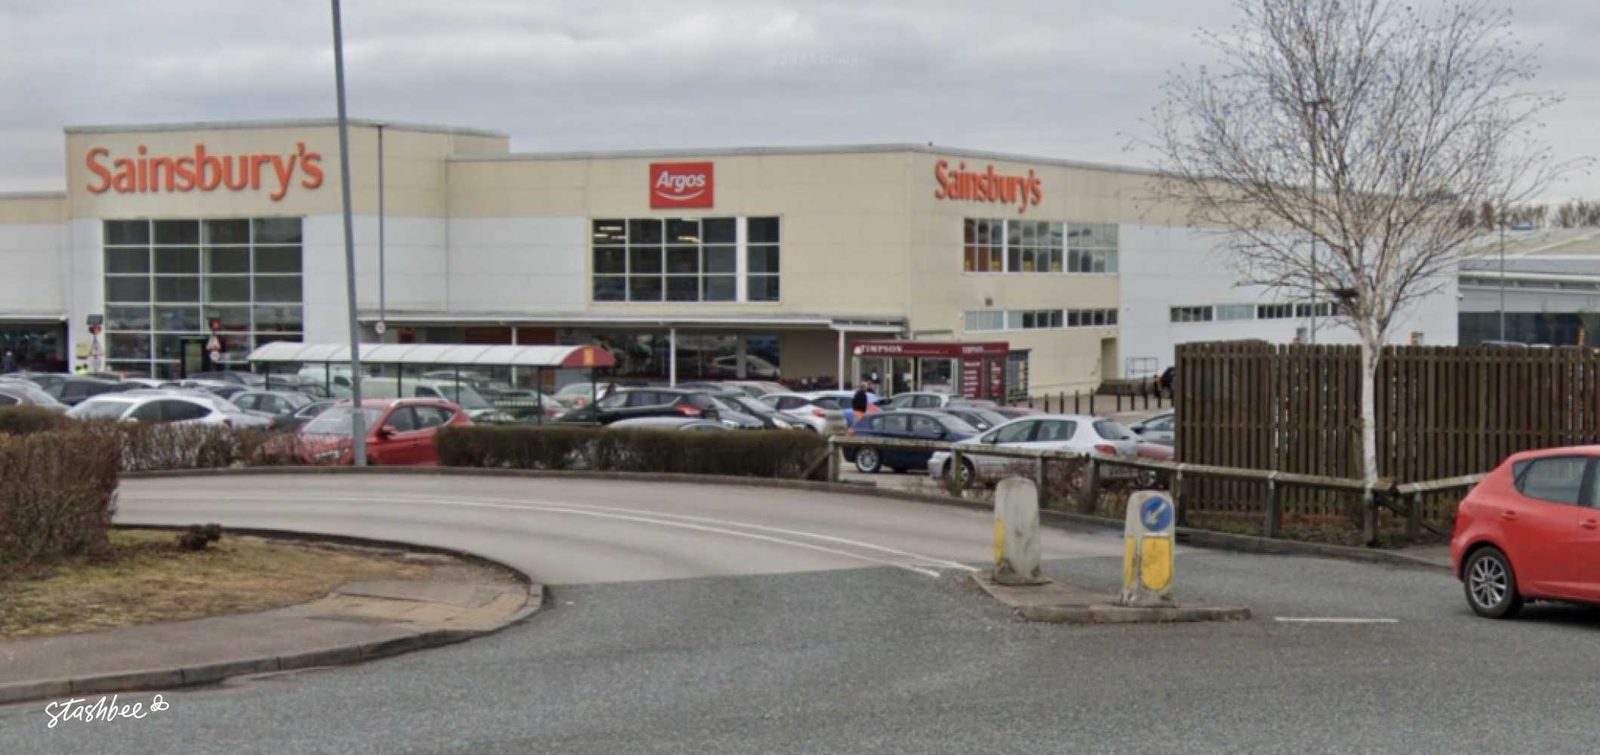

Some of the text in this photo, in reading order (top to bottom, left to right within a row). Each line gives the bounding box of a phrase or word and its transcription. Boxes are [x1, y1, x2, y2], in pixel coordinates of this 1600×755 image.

[86, 142, 323, 201] Sainsbury's
[655, 170, 706, 193] Argos
[935, 160, 1042, 214] Sainsbury's
[860, 344, 903, 353] TIMPSON
